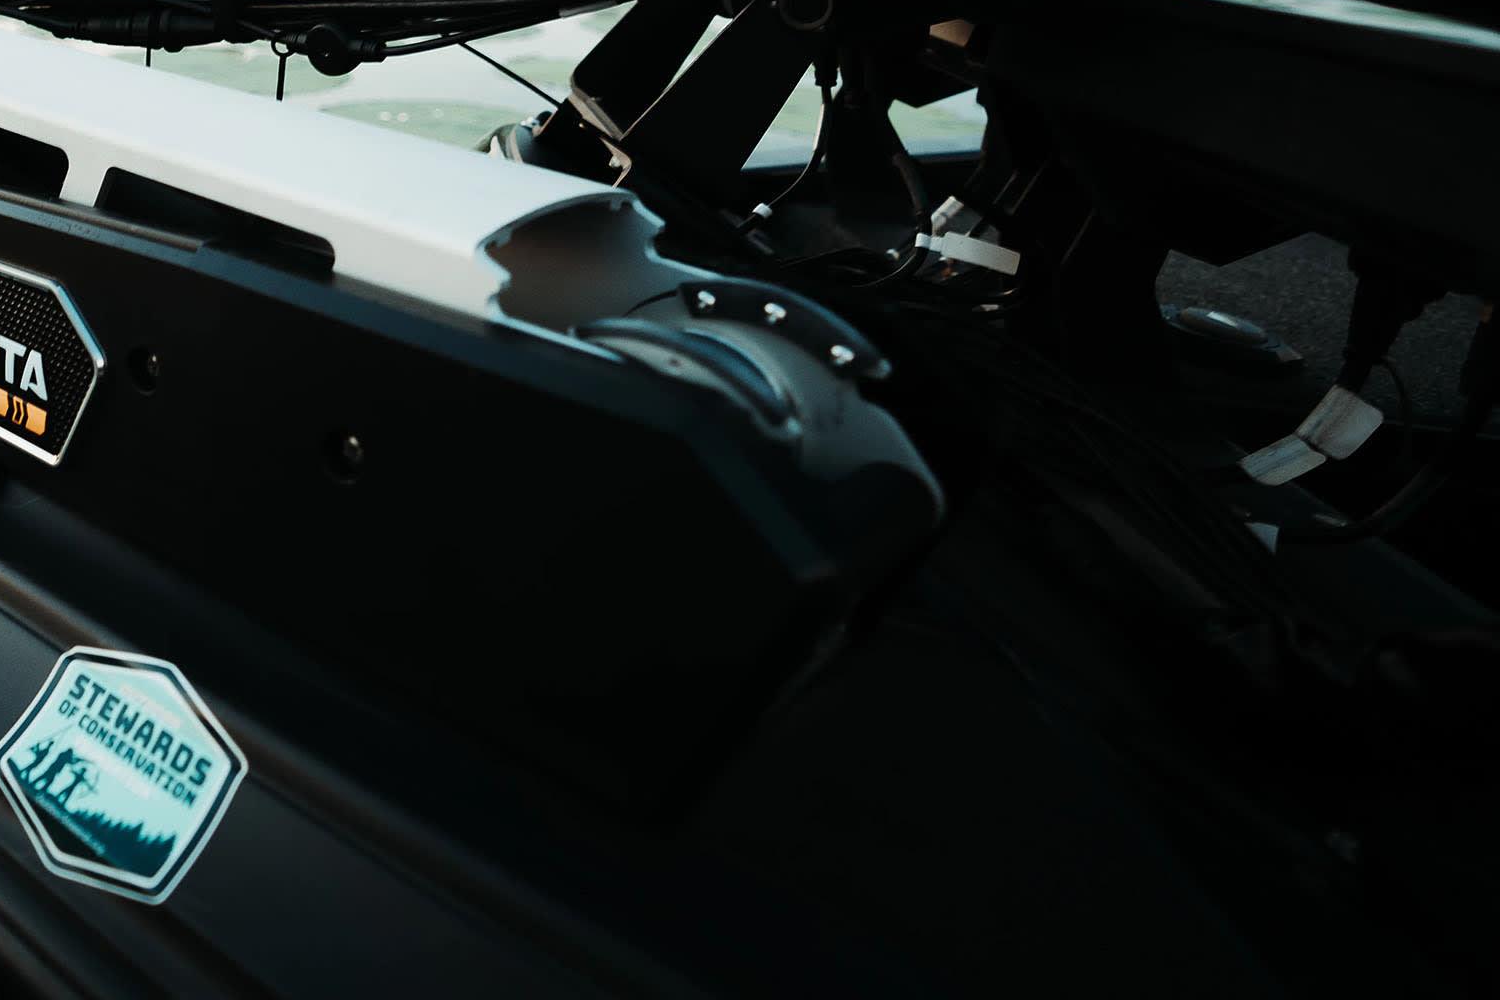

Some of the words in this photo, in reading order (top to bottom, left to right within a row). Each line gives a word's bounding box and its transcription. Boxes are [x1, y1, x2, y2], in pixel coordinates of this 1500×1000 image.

[58, 700, 79, 719] OF
[79, 714, 196, 807] CONSERVATION
[69, 674, 211, 786] STEWARDS
